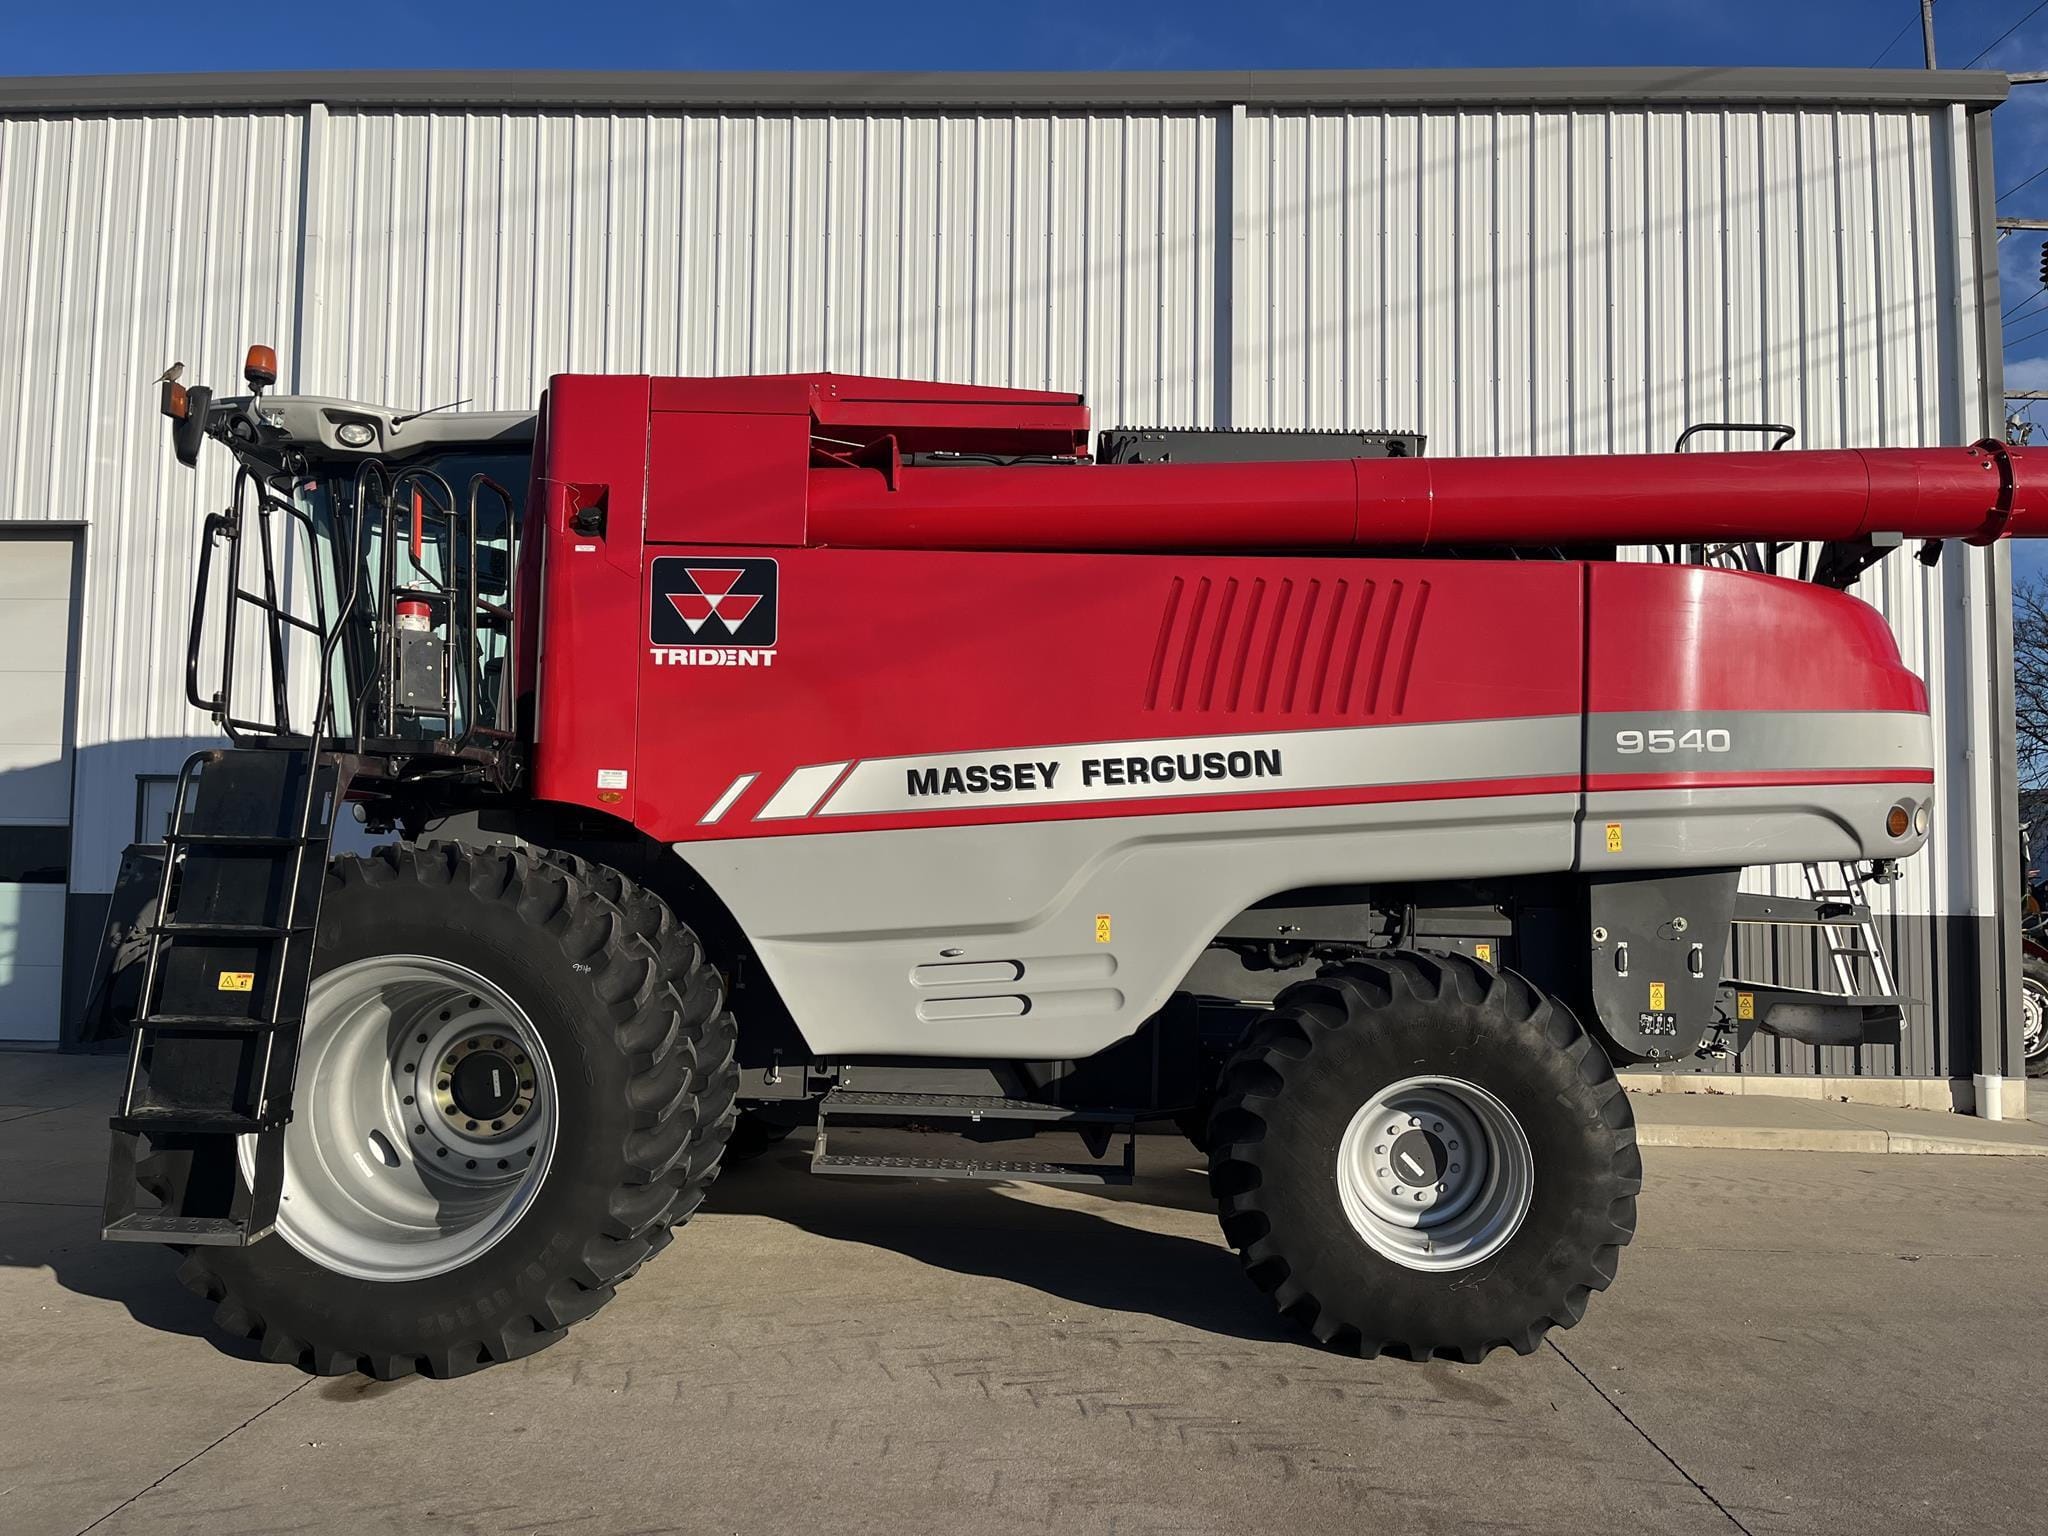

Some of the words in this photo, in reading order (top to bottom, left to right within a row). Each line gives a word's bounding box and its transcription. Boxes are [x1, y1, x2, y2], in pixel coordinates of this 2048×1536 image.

[650, 648, 777, 667] TRIDENT
[1616, 729, 1731, 754] 9540
[906, 762, 1059, 797] MASSEY
[1082, 749, 1282, 787] FERGUSON
